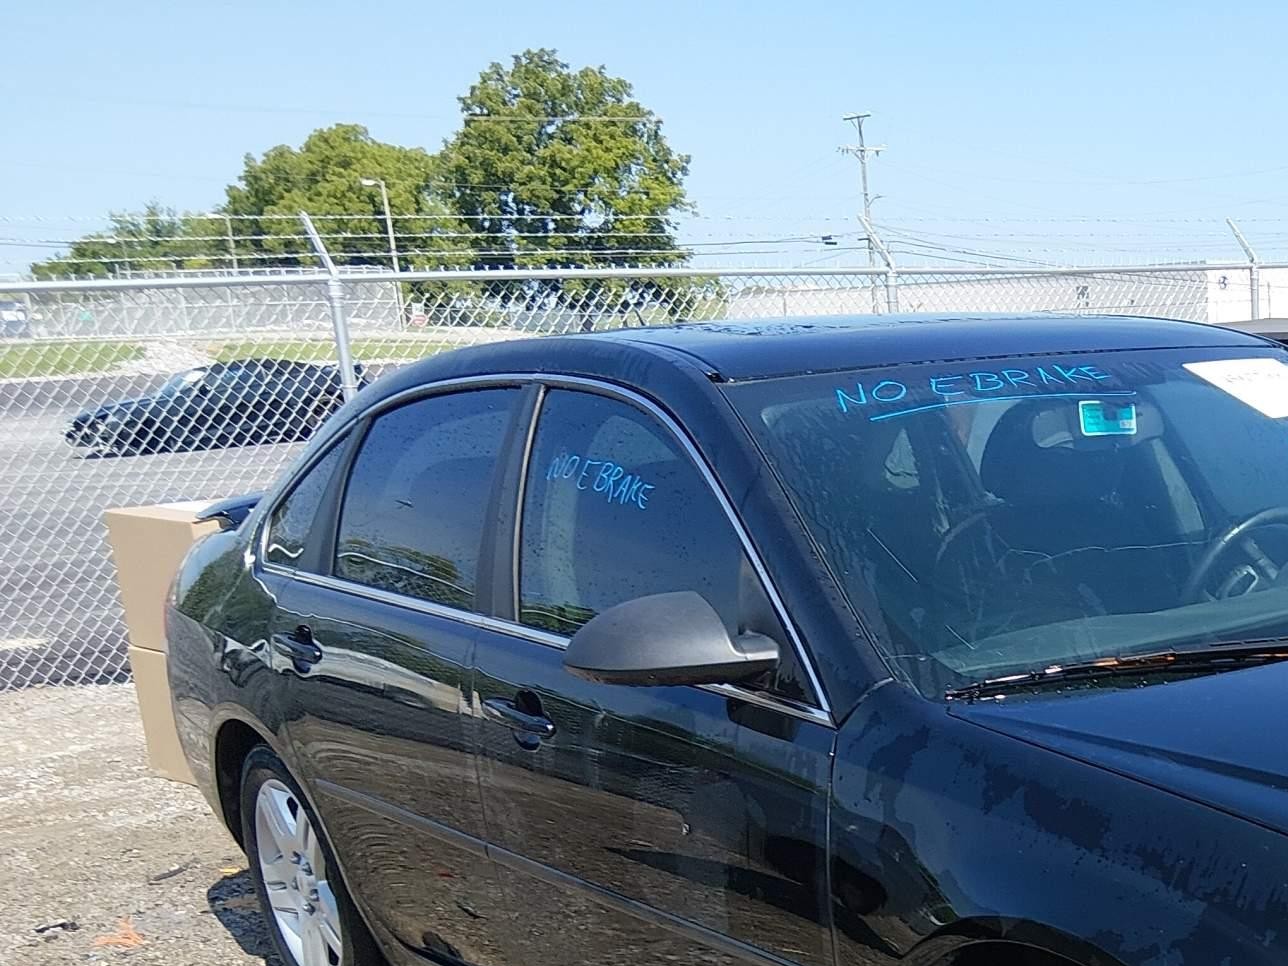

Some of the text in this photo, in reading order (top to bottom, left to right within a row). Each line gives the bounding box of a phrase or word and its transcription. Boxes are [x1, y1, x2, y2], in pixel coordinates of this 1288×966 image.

[835, 364, 1112, 412] NO EBRAKE
[546, 455, 656, 510] NO EBRAKE
